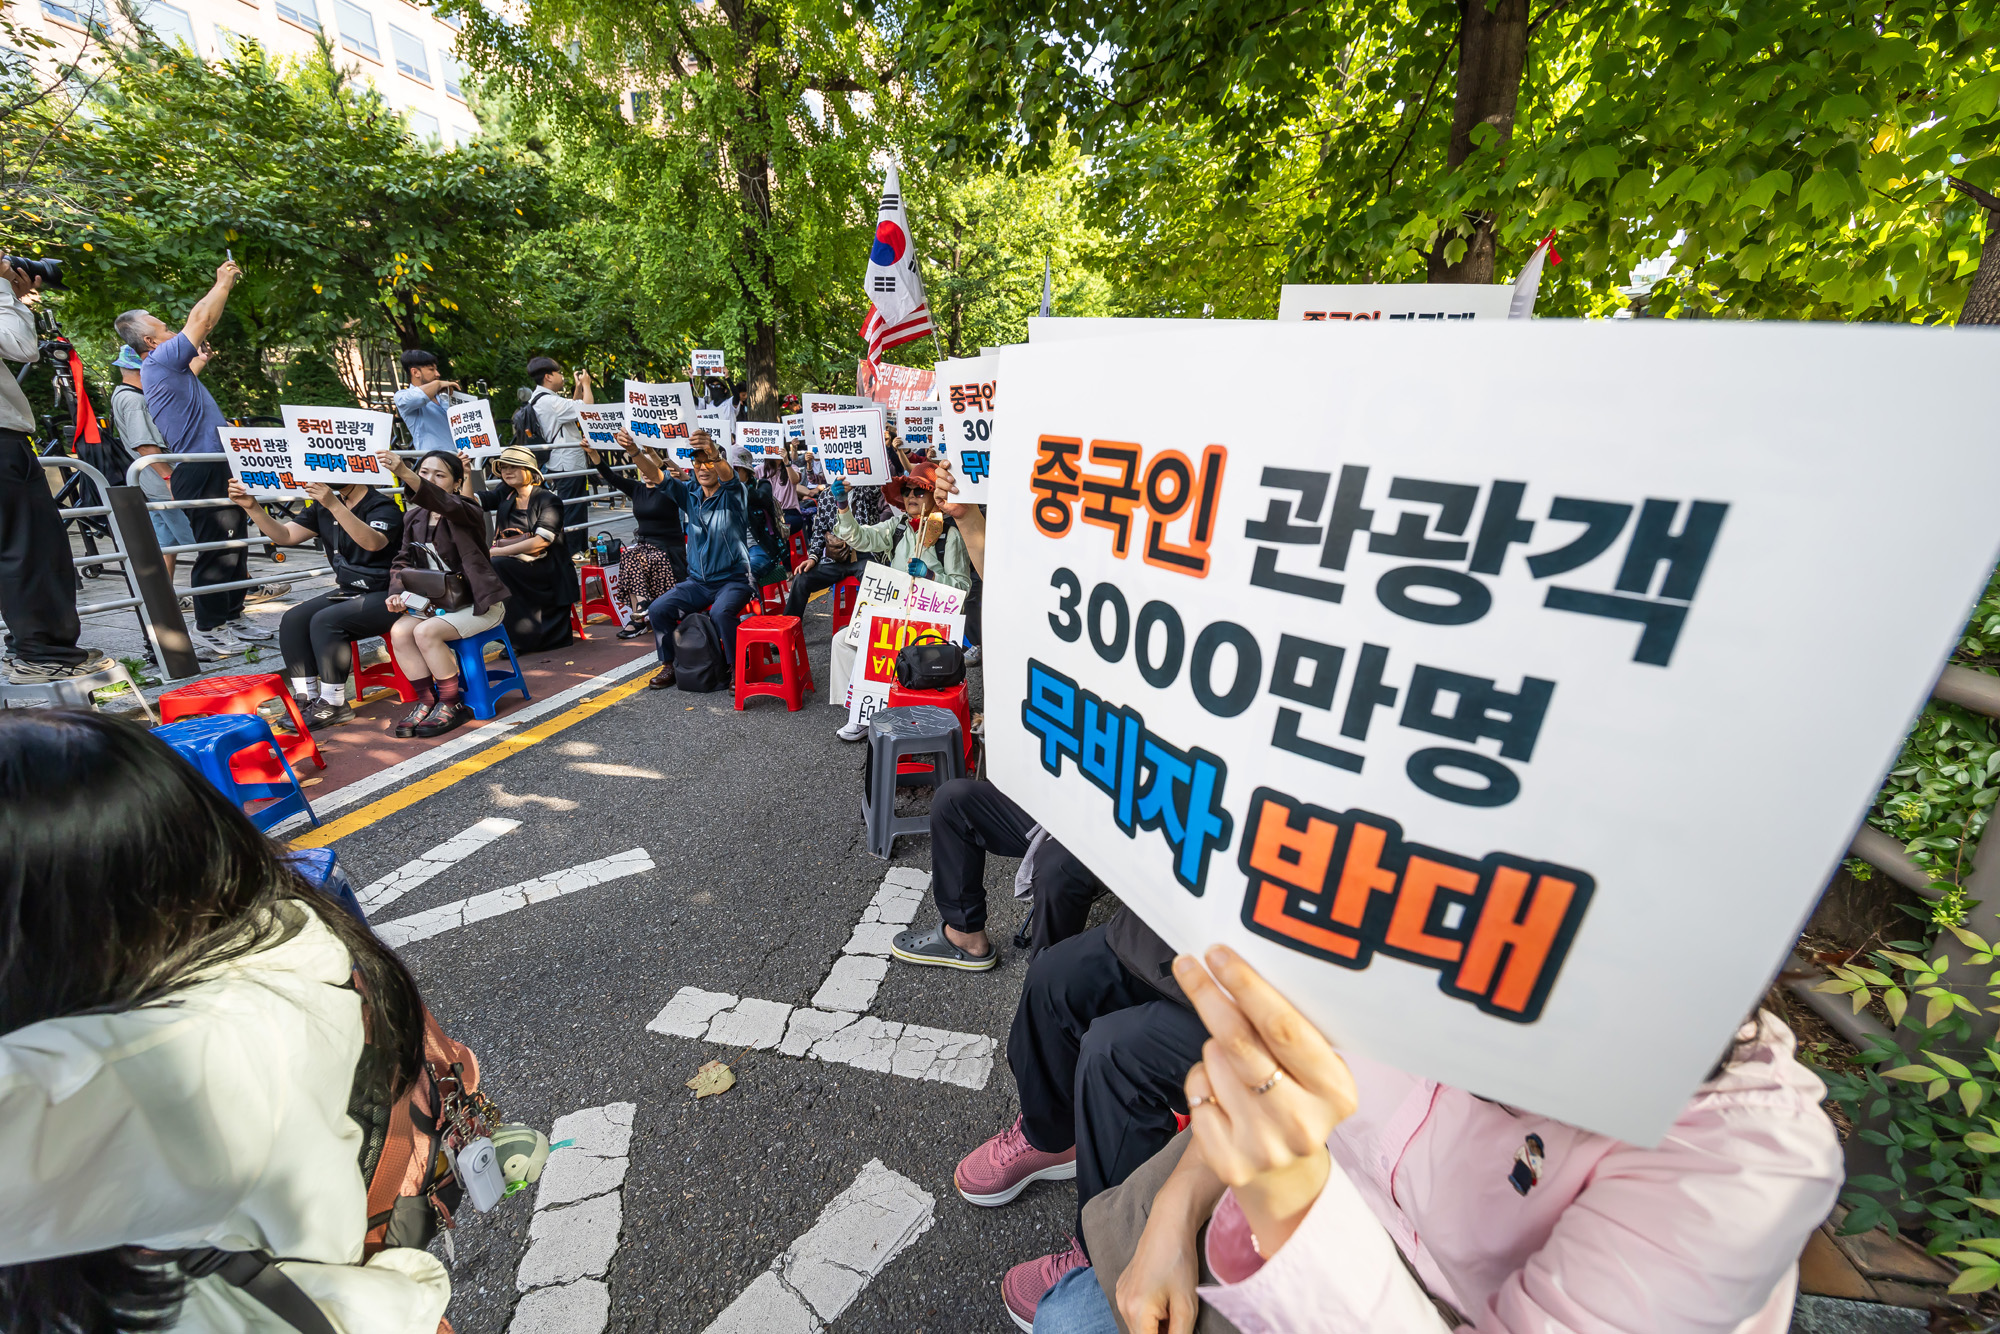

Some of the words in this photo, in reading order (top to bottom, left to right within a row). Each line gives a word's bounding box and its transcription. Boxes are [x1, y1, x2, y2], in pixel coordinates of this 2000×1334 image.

[629, 390, 648, 406] 중국인
[648, 394, 681, 407] 관광객
[632, 407, 678, 421] 3000만명
[811, 402, 836, 413] 중국인
[462, 409, 483, 422] 관광객
[580, 411, 601, 421] 중국인
[601, 411, 625, 420] 관광객
[904, 417, 922, 425] 중국인
[297, 418, 333, 434] 중국인
[335, 420, 374, 436] 관광객
[630, 420, 661, 439] 무비자
[660, 422, 690, 439] 반대
[743, 428, 760, 436] 중국인
[761, 429, 779, 437] 관광객
[819, 425, 838, 440] 중국인
[840, 424, 867, 438] 관광객
[962, 418, 993, 442] 30
[307, 437, 366, 452] 3000만명
[471, 433, 491, 448] 반대
[588, 431, 615, 443] 무비자
[905, 434, 927, 443] 무비자
[229, 438, 263, 453] 중국인
[263, 438, 290, 453] 관광
[765, 446, 780, 455] 반대
[824, 440, 863, 455] 3000만명
[304, 452, 347, 472] 무비자
[347, 454, 380, 473] 반대
[845, 457, 872, 475] 반대
[240, 471, 281, 489] 무비자
[1030, 434, 1228, 579] 중국인
[1244, 463, 1730, 668] 관광객
[1047, 566, 1558, 809] 3000만명
[1021, 657, 1234, 898] 무비자
[1238, 785, 1596, 1027] 반대
